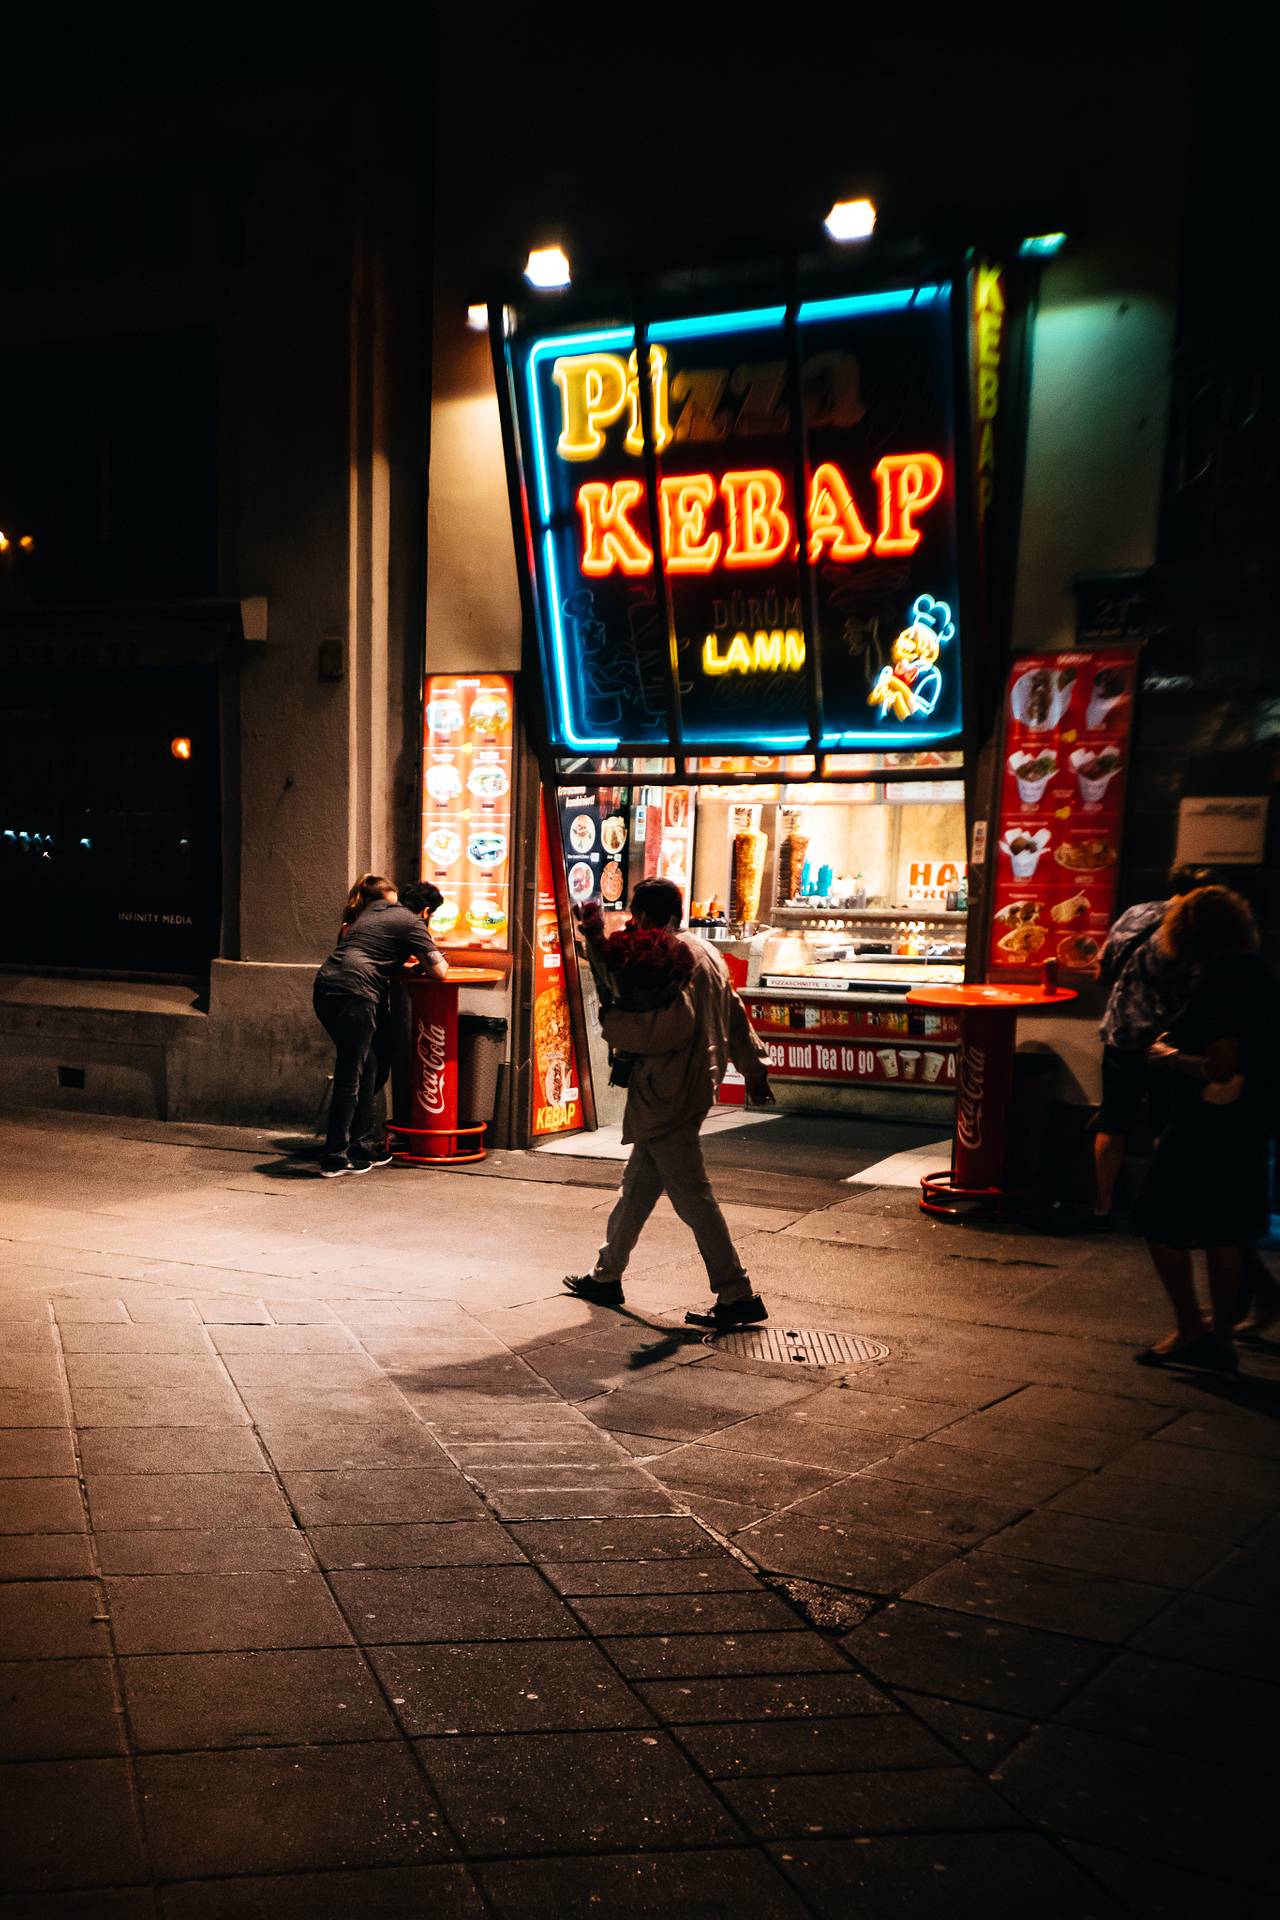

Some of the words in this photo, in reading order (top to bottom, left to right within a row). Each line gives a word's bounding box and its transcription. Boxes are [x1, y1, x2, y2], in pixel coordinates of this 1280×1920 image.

[552, 344, 867, 462] Pizza
[576, 453, 944, 577] KEBAP
[702, 629, 807, 676] LAMM
[910, 863, 968, 886] HA
[118, 911, 160, 923] INFINITY
[162, 913, 193, 925] MEDIA
[417, 1020, 445, 1114] Coca-Cola
[788, 1044, 812, 1069] und
[816, 1045, 837, 1071] Tea
[841, 1047, 854, 1072] to
[858, 1051, 875, 1074] go
[536, 1103, 576, 1130] KEBAP
